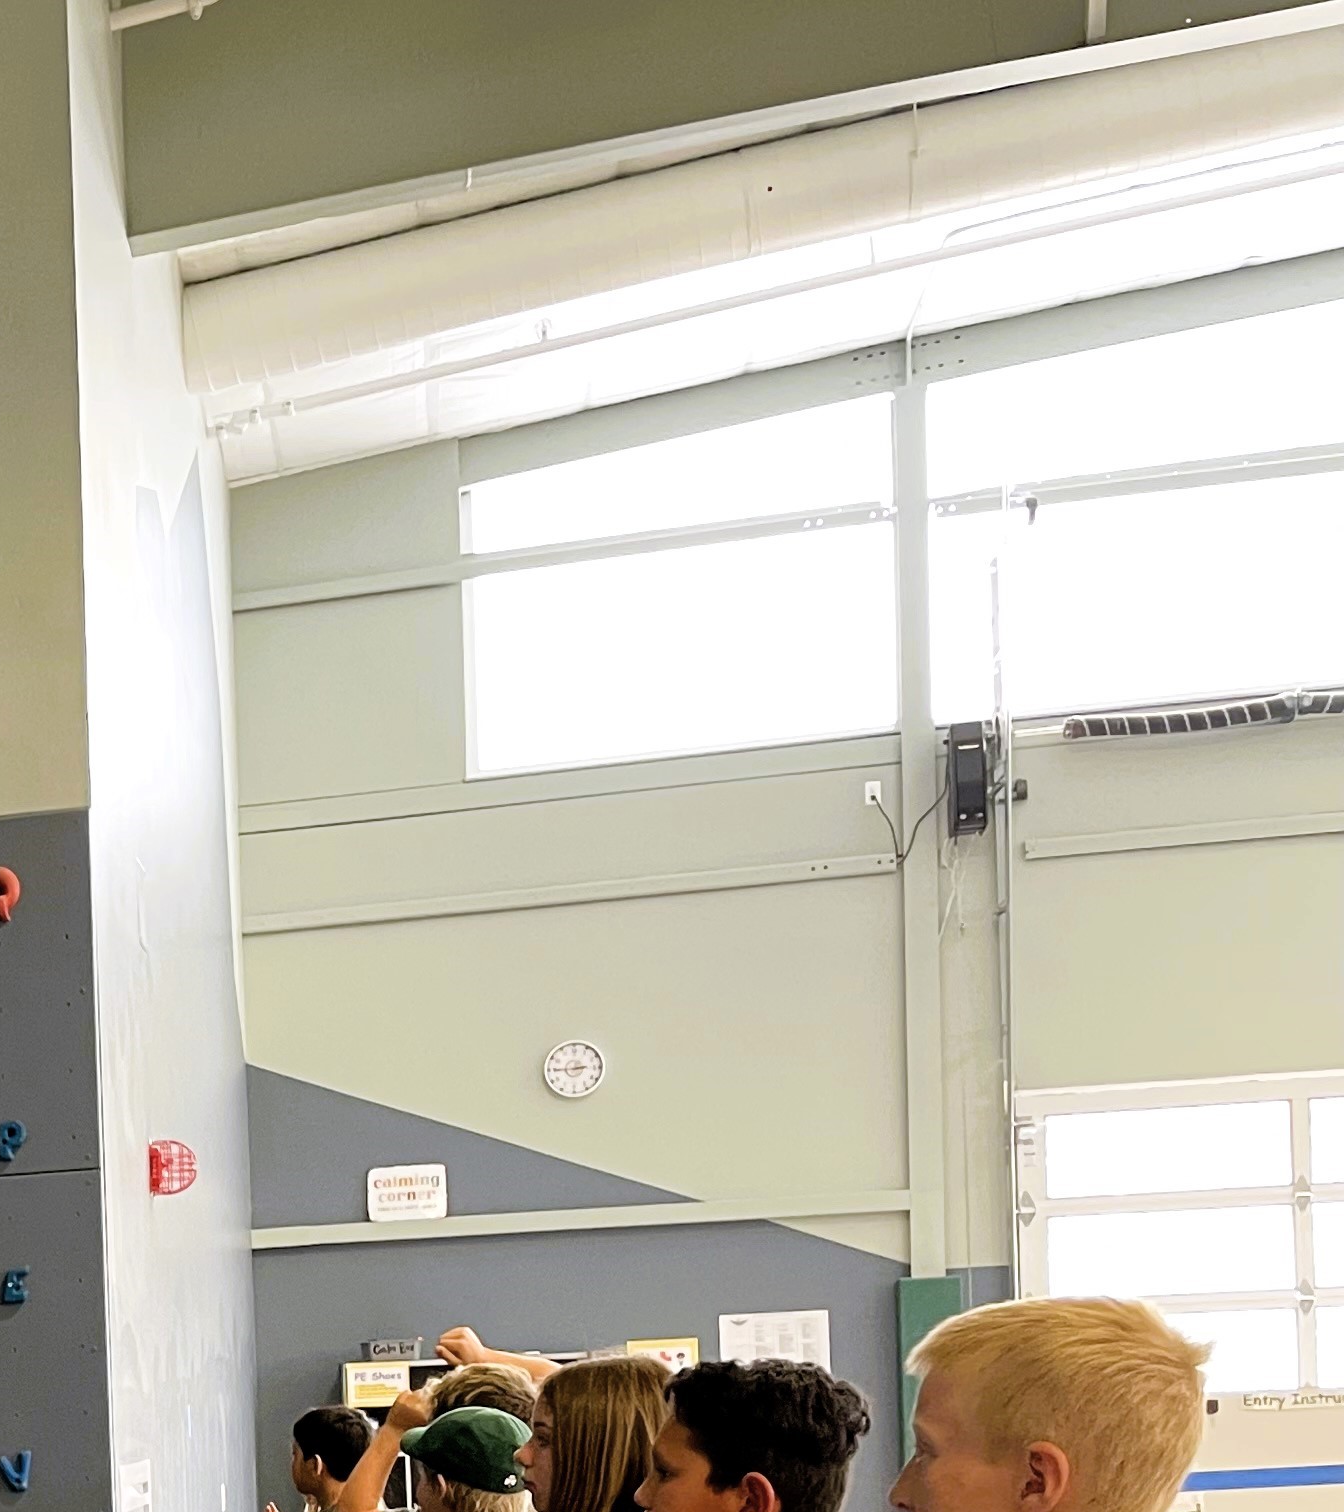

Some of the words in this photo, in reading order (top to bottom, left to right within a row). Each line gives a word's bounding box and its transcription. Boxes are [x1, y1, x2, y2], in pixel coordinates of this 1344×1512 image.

[373, 1173, 440, 1189] calming
[378, 1190, 436, 1203] corner
[2, 1264, 31, 1305] E
[372, 1371, 402, 1381] Shoes
[1243, 1393, 1286, 1411] Entry
[1292, 1393, 1344, 1405] Instru
